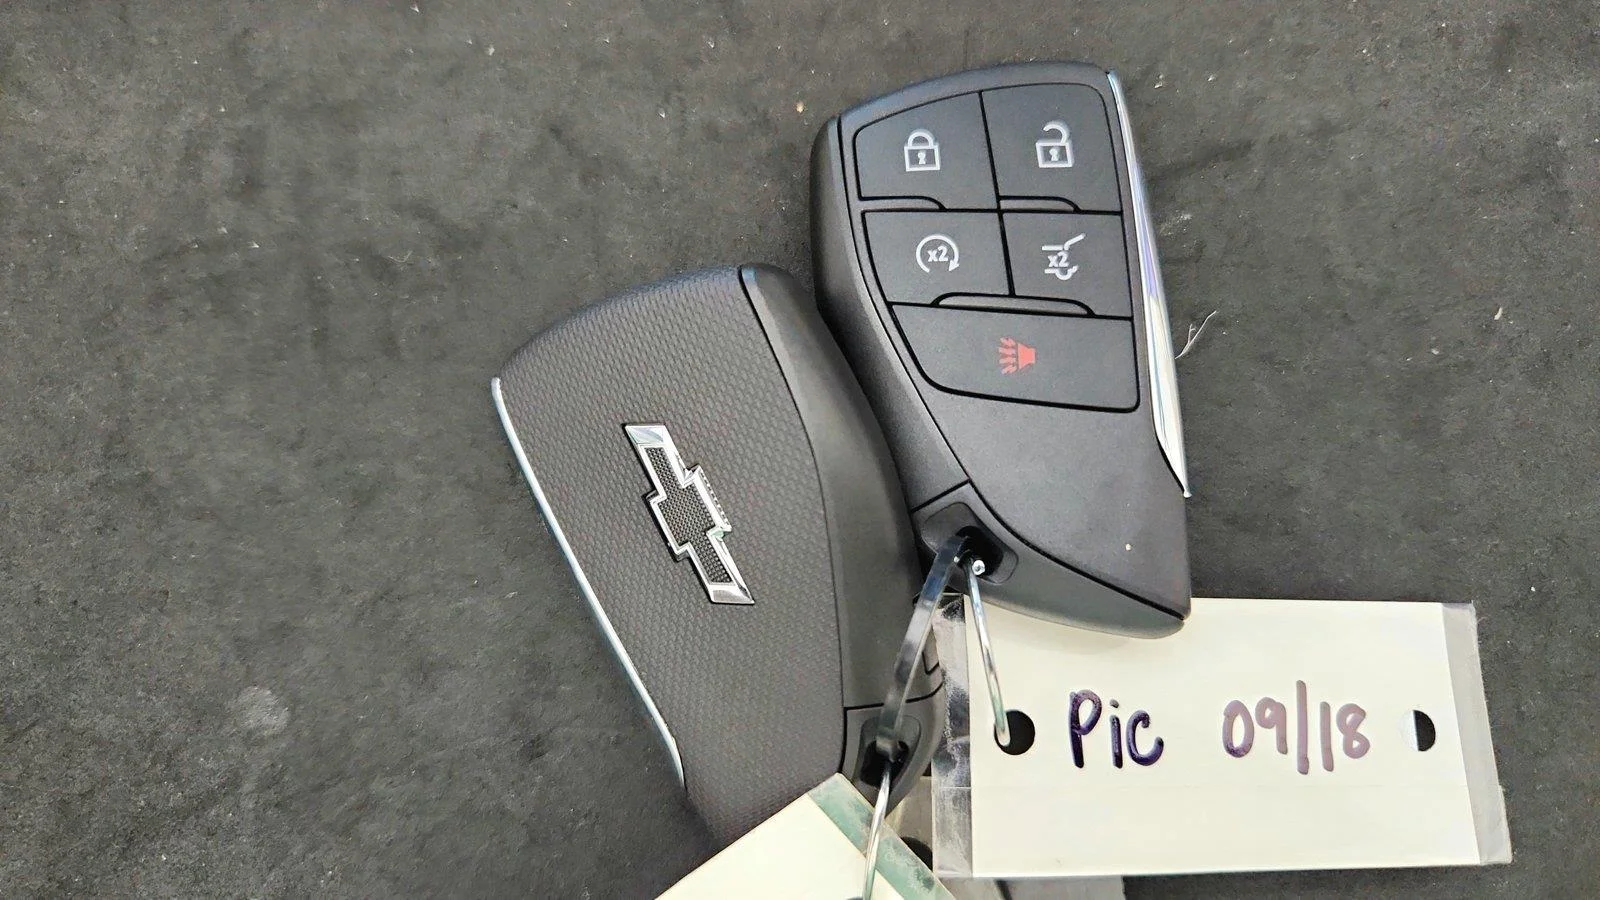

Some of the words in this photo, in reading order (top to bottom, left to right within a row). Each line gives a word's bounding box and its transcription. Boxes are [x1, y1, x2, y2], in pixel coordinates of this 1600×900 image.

[927, 245, 949, 262] x2
[1047, 251, 1069, 268] x2
[1068, 689, 1164, 769] Pic
[1222, 679, 1371, 775] 09/18
